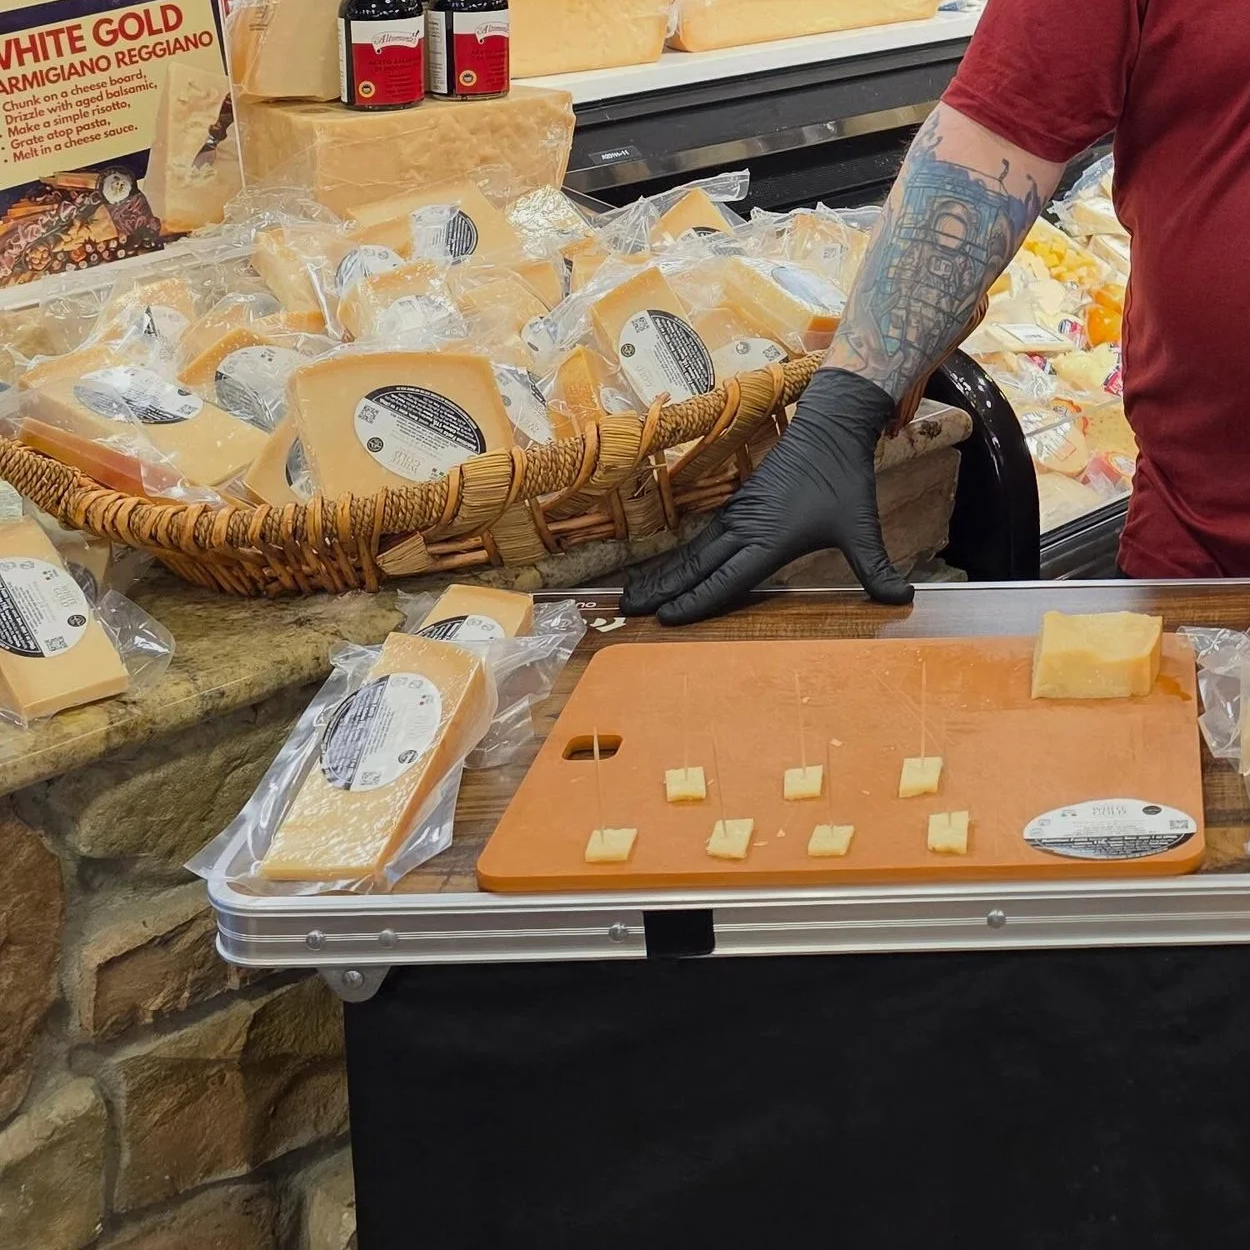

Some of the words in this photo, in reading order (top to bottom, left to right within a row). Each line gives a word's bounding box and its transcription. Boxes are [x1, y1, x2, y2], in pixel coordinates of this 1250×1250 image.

[92, 4, 183, 48] GOLD
[0, 54, 111, 95] ARMIGIANO
[115, 30, 213, 69] REGGIANO
[2, 95, 41, 112] Chunk
[43, 93, 58, 103] on
[60, 89, 69, 99] a
[71, 78, 108, 96] cheese
[109, 68, 147, 87] board,
[5, 107, 45, 125] Drizzle
[47, 100, 74, 116] with
[76, 92, 104, 111] aged
[105, 80, 158, 100] balsamic,
[8, 122, 41, 138] Make
[43, 120, 51, 129] a
[53, 109, 90, 130] simple
[92, 101, 131, 118] risotto,
[10, 134, 45, 150] Grate
[47, 127, 73, 144] atop
[75, 118, 111, 139] pasta,
[13, 146, 39, 163] Melt
[40, 143, 52, 155] in
[54, 142, 62, 152] a
[64, 132, 101, 149] cheese
[103, 124, 138, 140] sauce.
